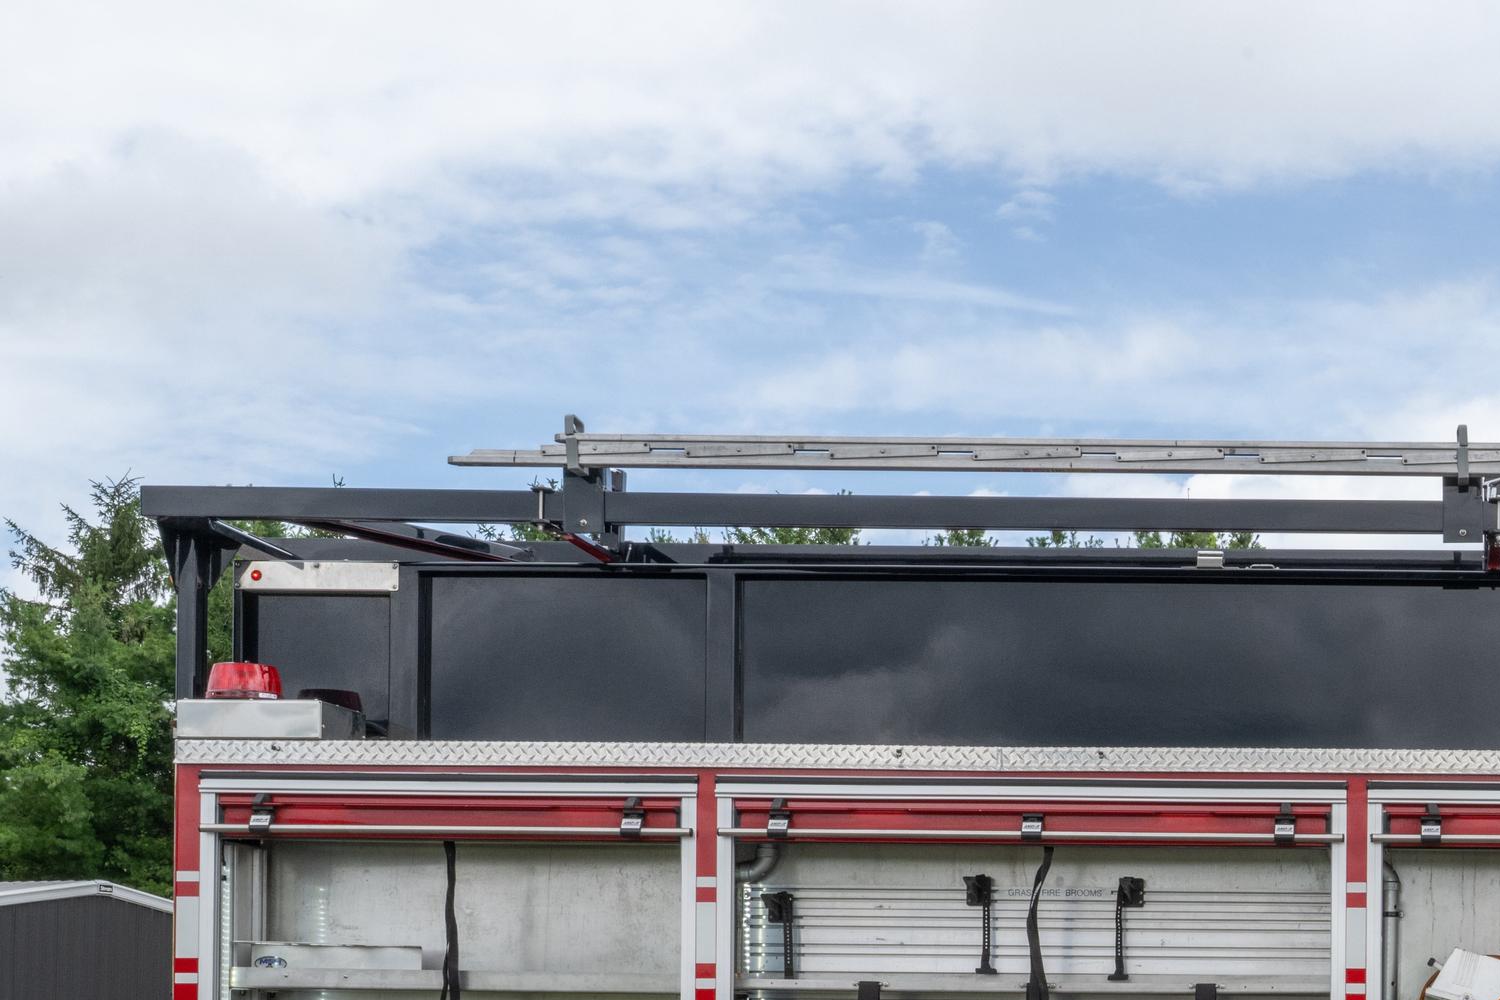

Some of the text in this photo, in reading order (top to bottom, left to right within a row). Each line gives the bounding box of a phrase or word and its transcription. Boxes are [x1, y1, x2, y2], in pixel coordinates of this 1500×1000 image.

[1007, 888, 1103, 897] GRAS FIRE BROOMS
